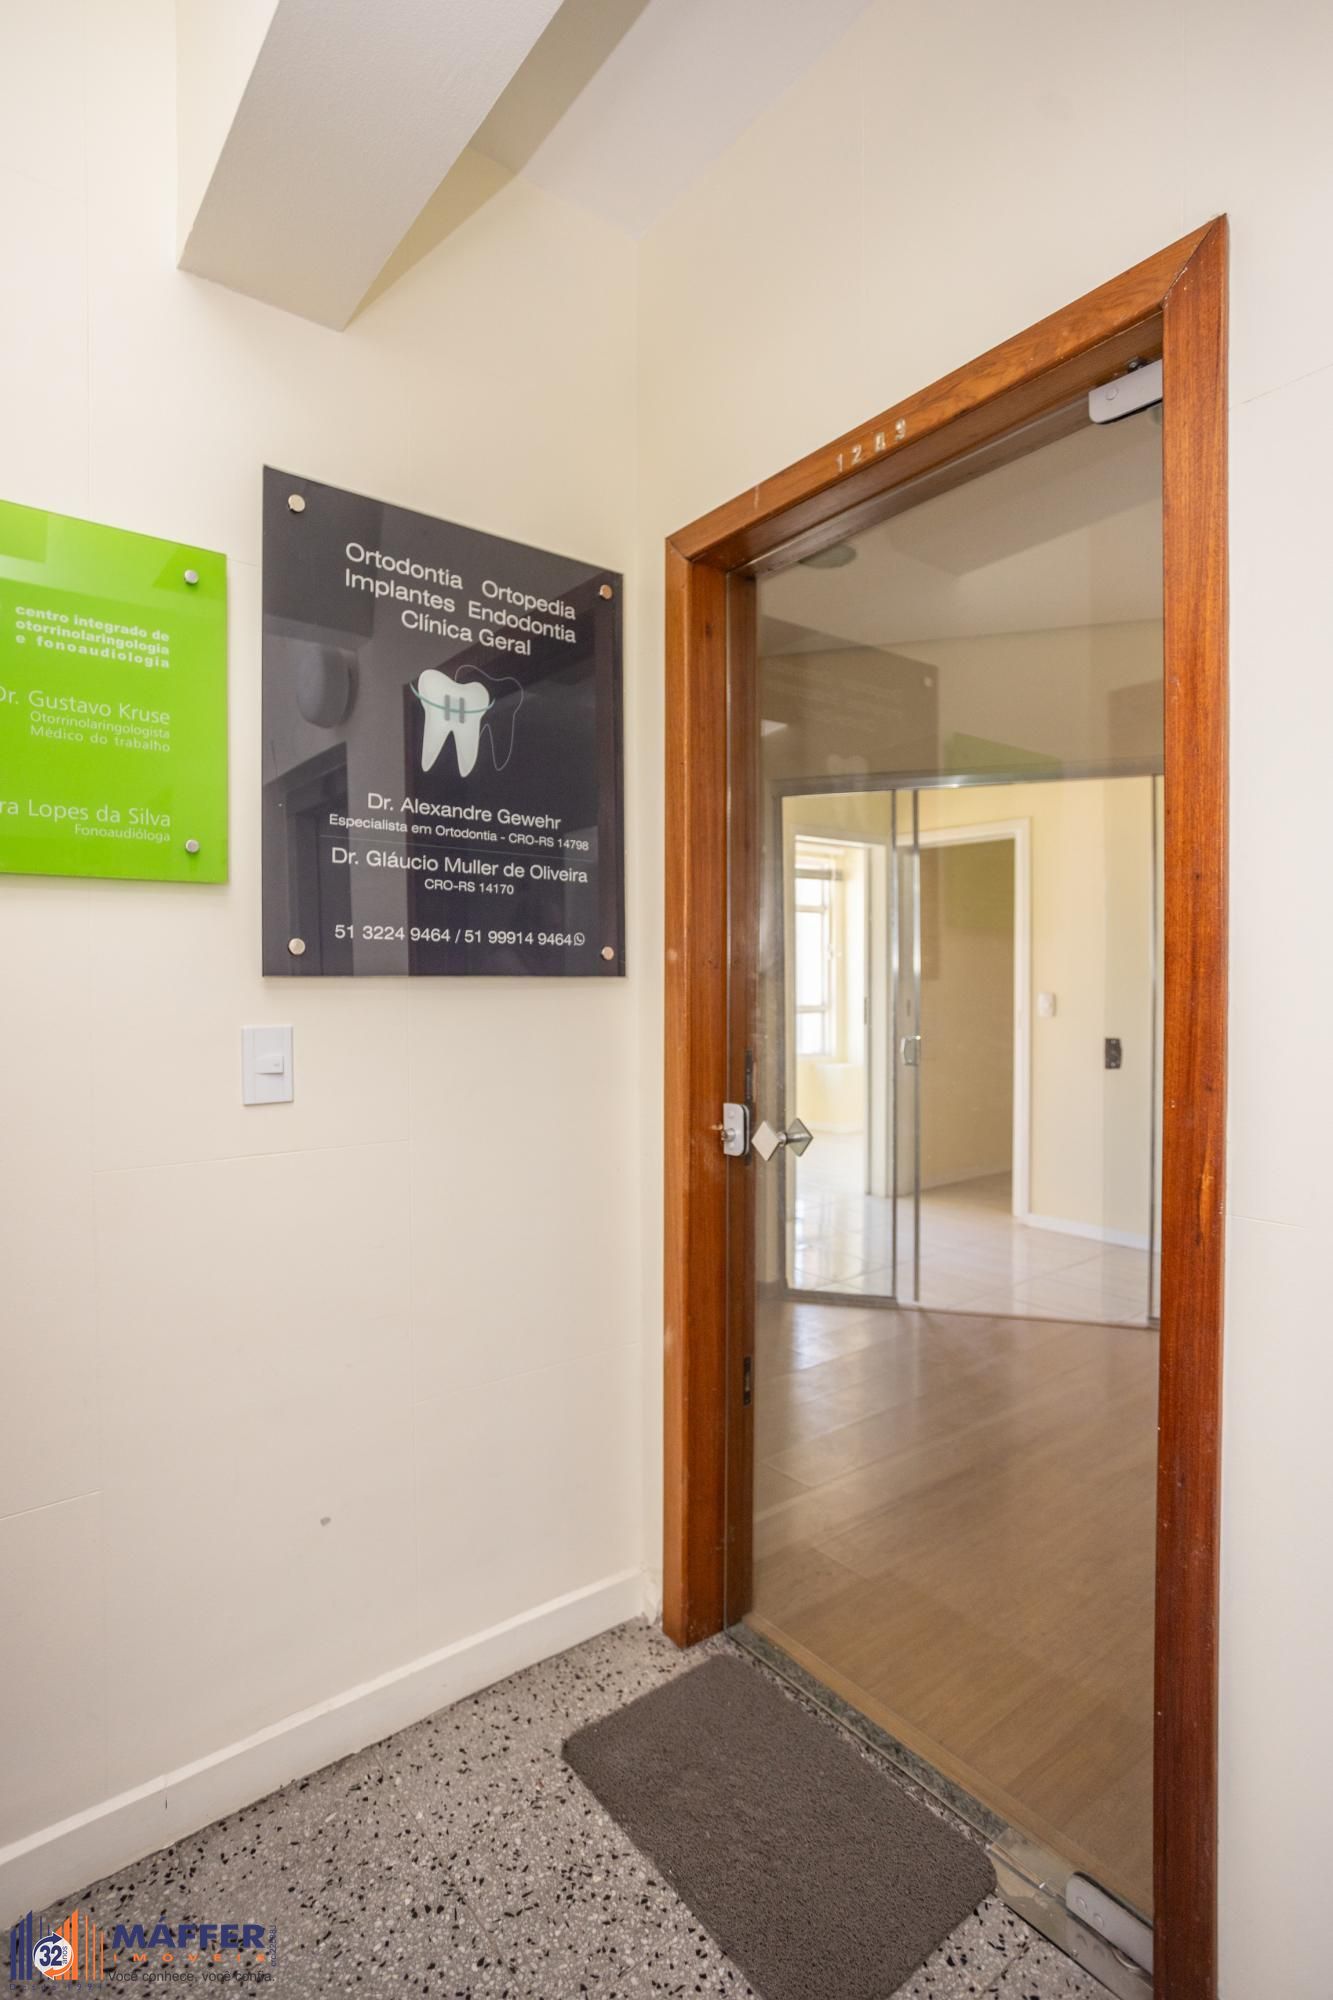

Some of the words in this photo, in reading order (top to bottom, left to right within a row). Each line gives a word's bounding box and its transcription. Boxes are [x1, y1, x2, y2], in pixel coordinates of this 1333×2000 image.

[345, 543, 463, 590] Ortodontia
[482, 579, 576, 620] Ortopedia
[345, 568, 455, 613] Implantes
[468, 600, 576, 643] Endodontia
[15, 606, 69, 623] centro
[74, 614, 147, 638] integrado
[152, 629, 170, 642] de
[15, 620, 169, 655] otorrinolaringologia
[401, 609, 473, 642] Clínica
[479, 628, 531, 656] Geral
[15, 634, 26, 644] e
[36, 635, 170, 668] fonoaudiologia
[29, 689, 112, 717] Gustavo
[119, 702, 170, 725] Kruse
[30, 710, 170, 740] Otorrinolaringologista
[30, 725, 84, 742] Médico
[90, 733, 108, 745] do
[115, 736, 170, 753] trabalho
[29, 799, 89, 823] Lopes
[96, 803, 120, 823] da
[128, 807, 170, 828] Silva
[368, 792, 393, 811] Dr.
[400, 797, 492, 822] Alexandre
[497, 808, 561, 830] Gewehr
[75, 823, 170, 844] Fonoaudióloga
[329, 813, 408, 833] Especialista
[411, 824, 432, 835] em
[435, 825, 497, 841] Ortodontia
[508, 832, 554, 847] CRO-RS
[558, 838, 589, 851] 14798
[331, 847, 359, 865] Dr.
[366, 850, 438, 871] Gláucio
[444, 857, 499, 876] Muller
[503, 862, 525, 877] de
[530, 864, 588, 883] Oliveira
[424, 878, 475, 892] CRO-RS
[479, 882, 514, 895] 14170
[334, 924, 355, 939] 51
[362, 926, 405, 941] 3224
[410, 927, 450, 943] 9464
[454, 929, 461, 943] /
[464, 928, 482, 943] 51
[488, 930, 534, 945] 99914
[538, 931, 572, 946] 9464
